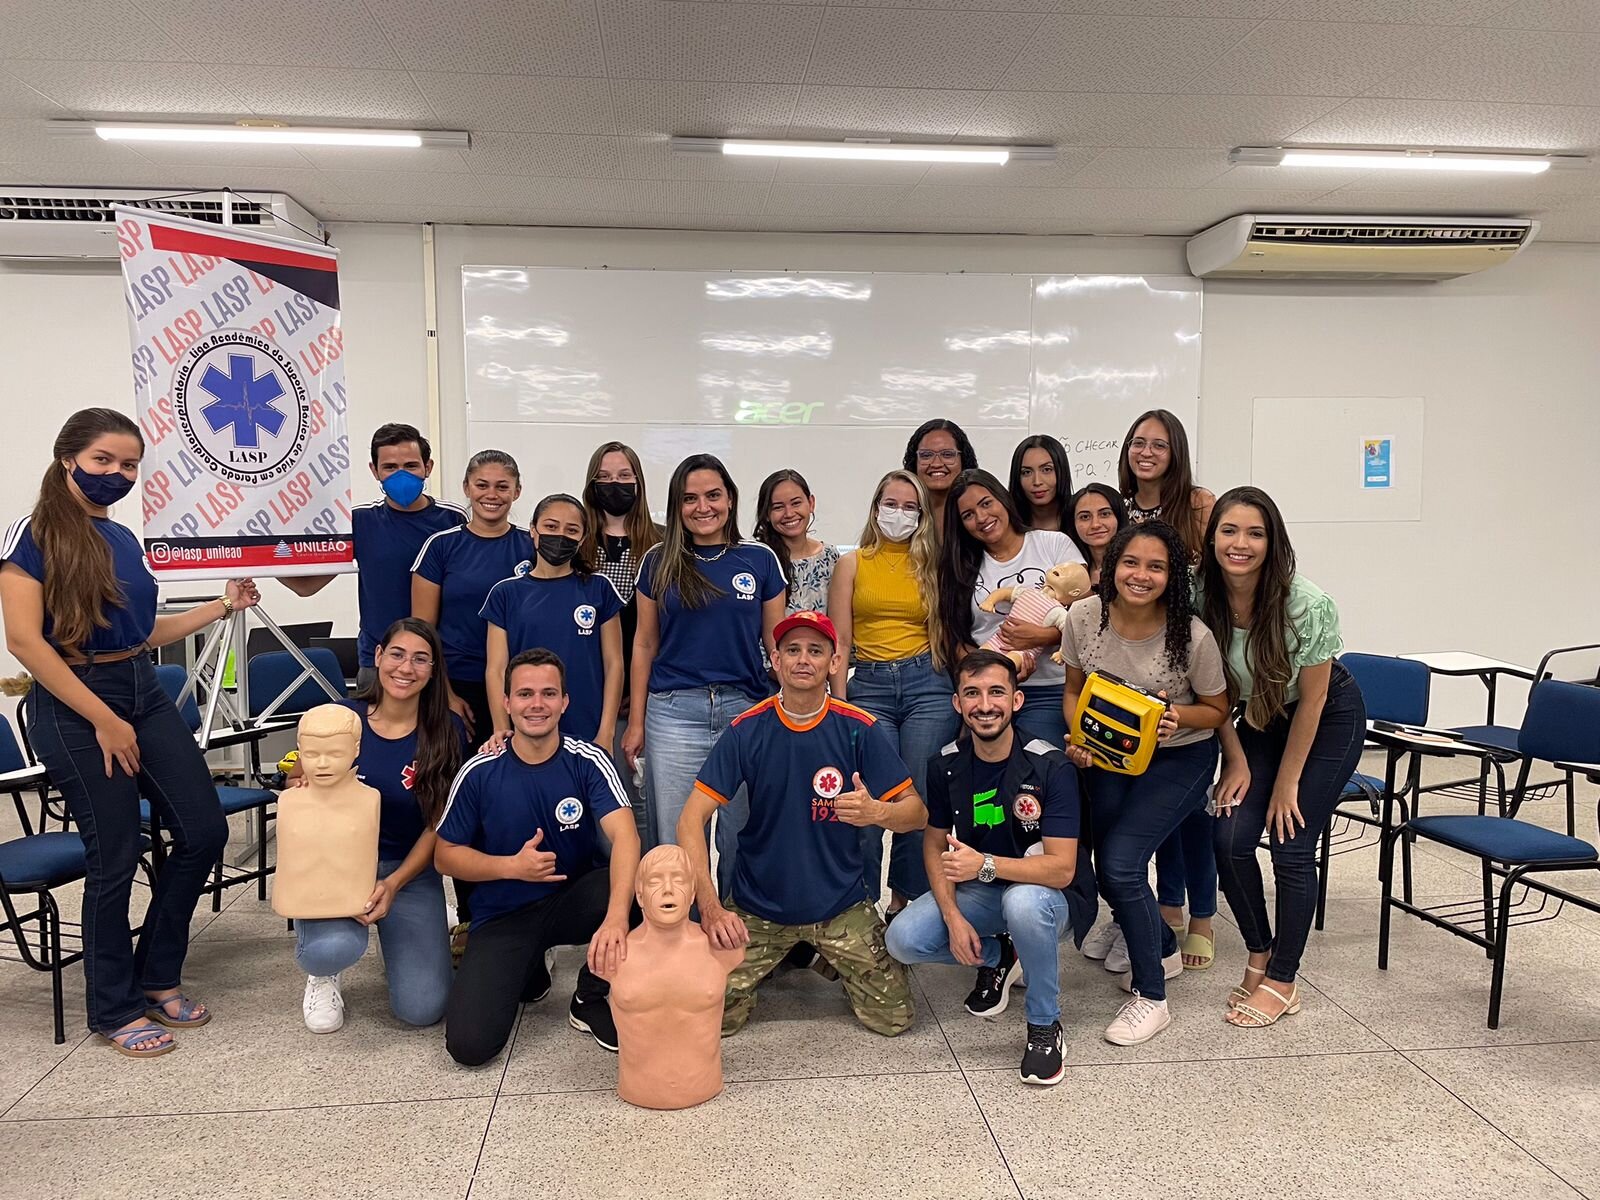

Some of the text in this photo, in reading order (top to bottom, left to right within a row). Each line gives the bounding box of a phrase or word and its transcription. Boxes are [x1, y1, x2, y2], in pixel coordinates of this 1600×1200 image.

[152, 309, 203, 365] LASP
[200, 275, 252, 329] LASP
[734, 400, 825, 423] acer
[1075, 440, 1119, 453] CHECAR
[228, 450, 268, 464] LASP
[268, 471, 313, 525] LASP
[171, 545, 242, 561] @lasp_unileao
[293, 538, 347, 553] UNILEÃO
[811, 798, 833, 807] SAM
[559, 823, 580, 832] LASP
